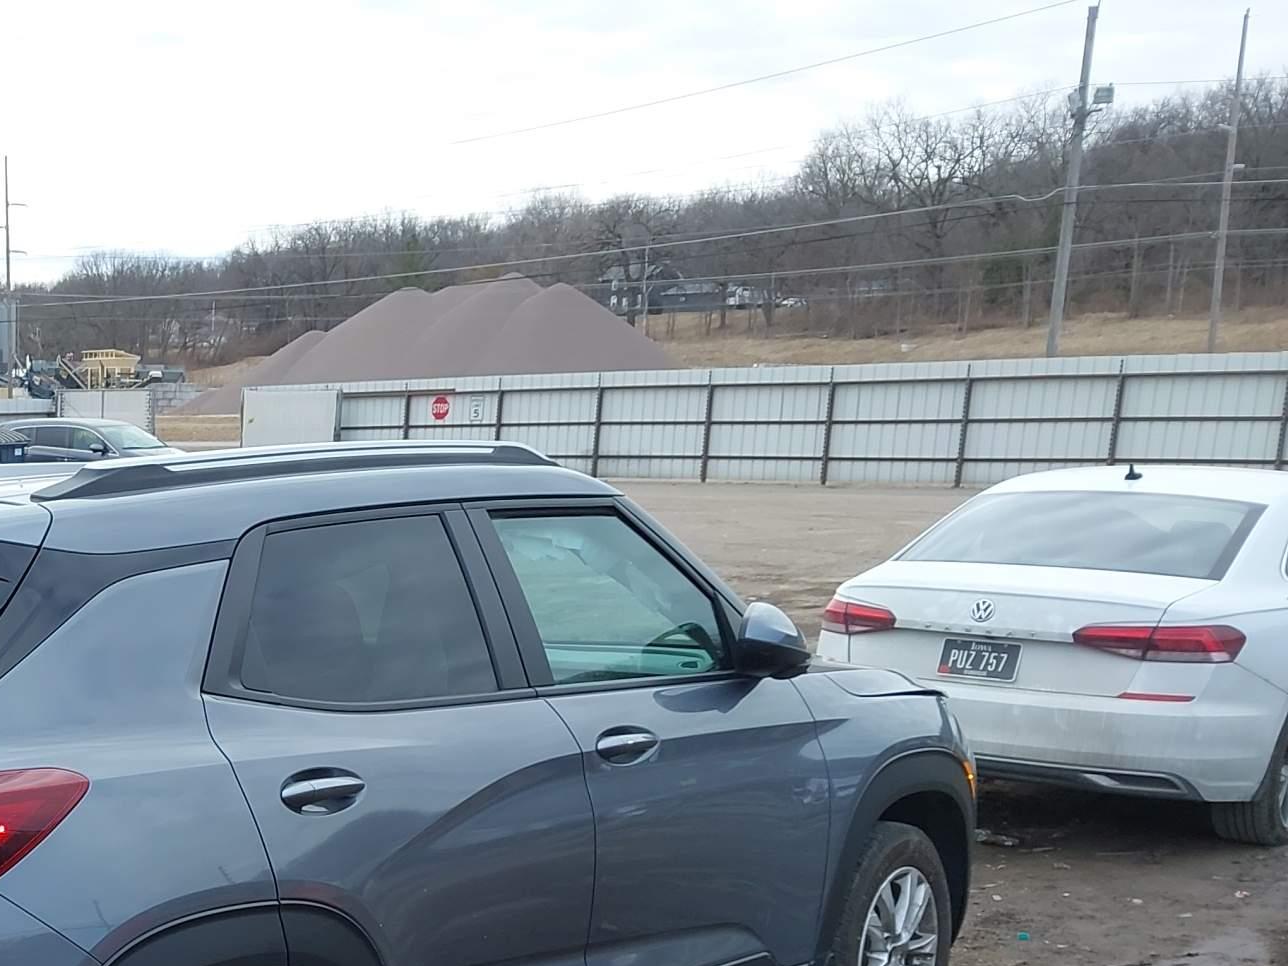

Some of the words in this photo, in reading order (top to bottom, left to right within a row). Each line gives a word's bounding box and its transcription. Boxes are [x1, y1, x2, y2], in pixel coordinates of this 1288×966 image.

[432, 403, 449, 414] STOP
[473, 408, 480, 418] 5
[948, 649, 976, 669] PUZ
[979, 652, 1008, 672] 757
